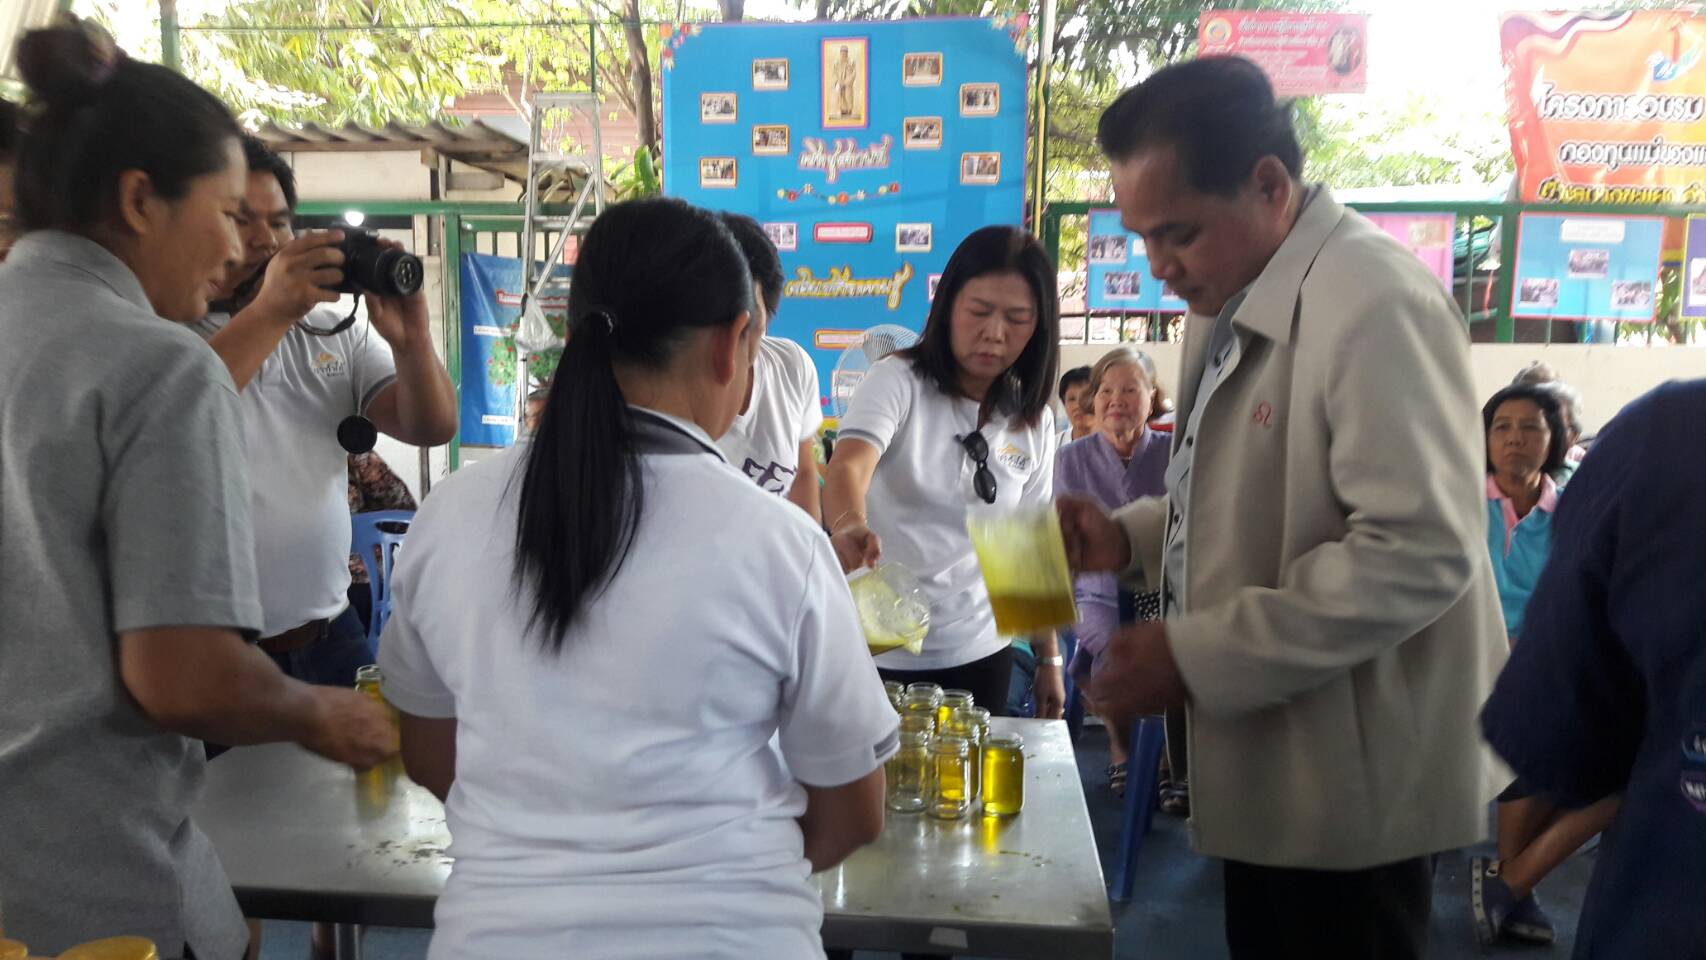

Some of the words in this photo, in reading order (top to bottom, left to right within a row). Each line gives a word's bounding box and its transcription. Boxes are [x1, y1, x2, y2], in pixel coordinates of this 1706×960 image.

[1540, 82, 1705, 121] โครงการอบรม
